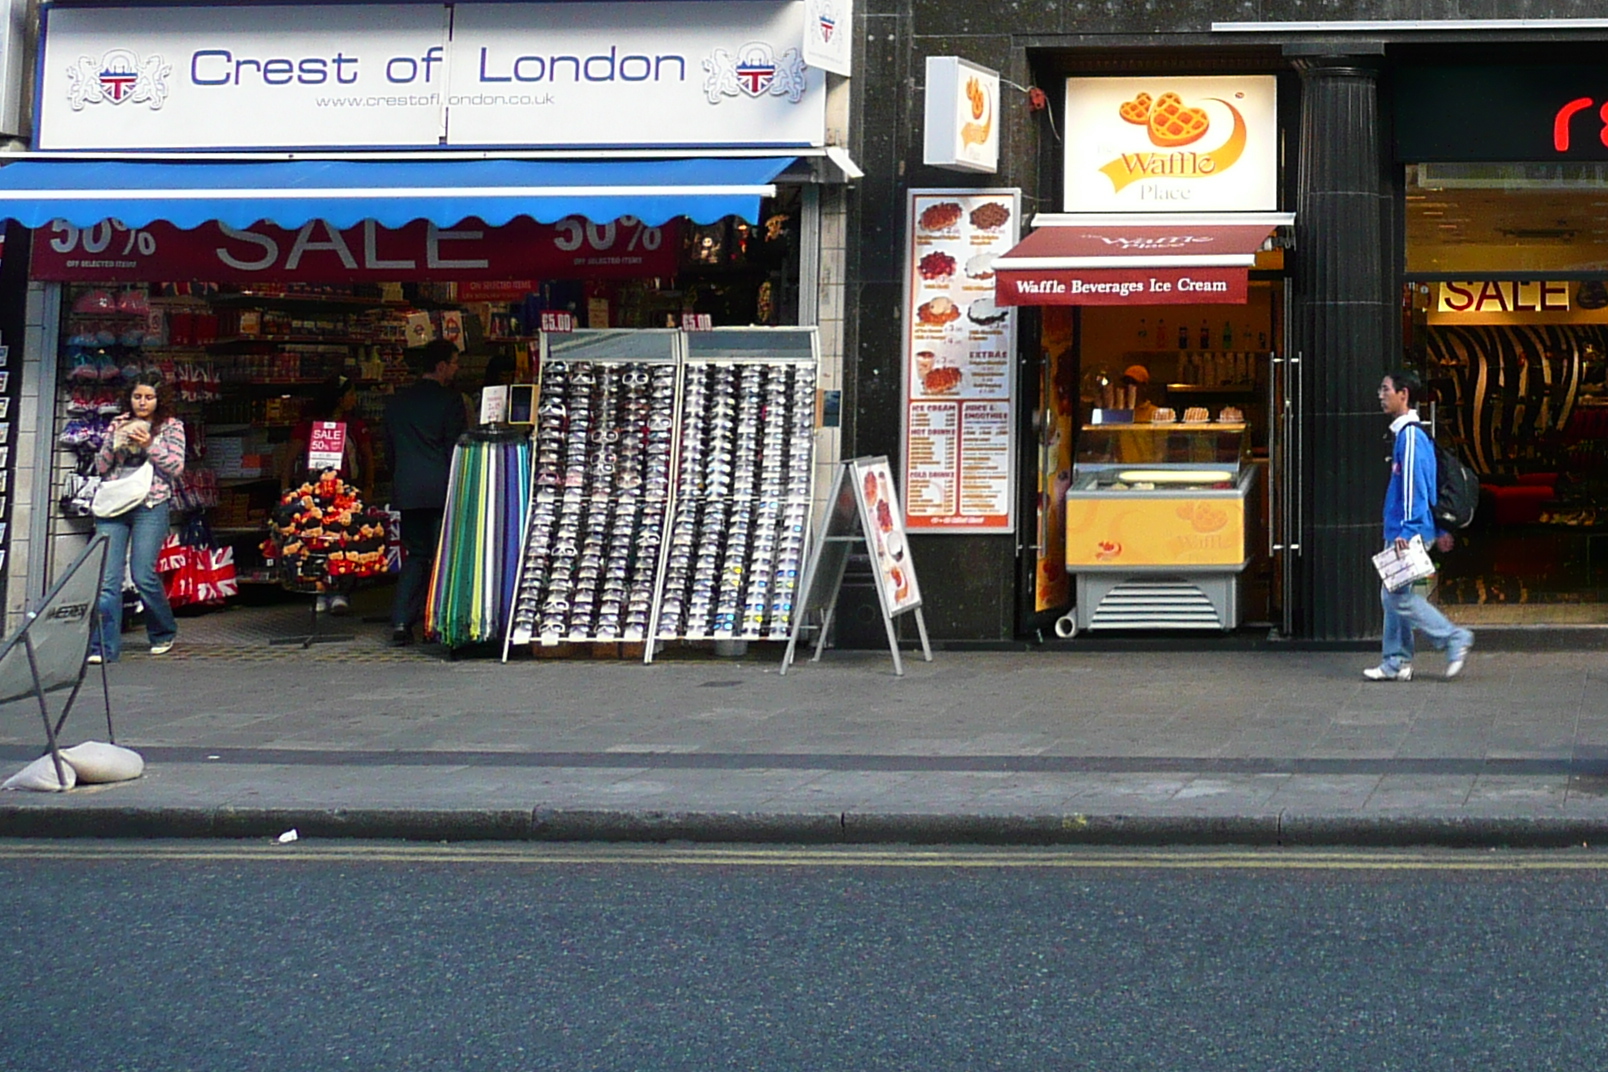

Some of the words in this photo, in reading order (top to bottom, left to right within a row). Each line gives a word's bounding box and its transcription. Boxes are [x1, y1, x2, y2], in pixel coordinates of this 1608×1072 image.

[190, 49, 358, 86] Crest
[385, 46, 444, 84] of
[479, 45, 686, 82] London
[1121, 151, 1216, 175] Waffle
[1141, 184, 1191, 200] Place
[216, 218, 489, 271] SALE
[587, 257, 621, 265] SELECTED
[1015, 279, 1066, 294] Waffle
[1071, 279, 1144, 297] Beverages
[1149, 278, 1172, 292] Ice
[1177, 277, 1228, 292] Cream
[1443, 281, 1569, 312] SALE
[542, 313, 571, 331] £5.00
[969, 351, 1008, 359] EXTRAS
[313, 430, 342, 440] SALE
